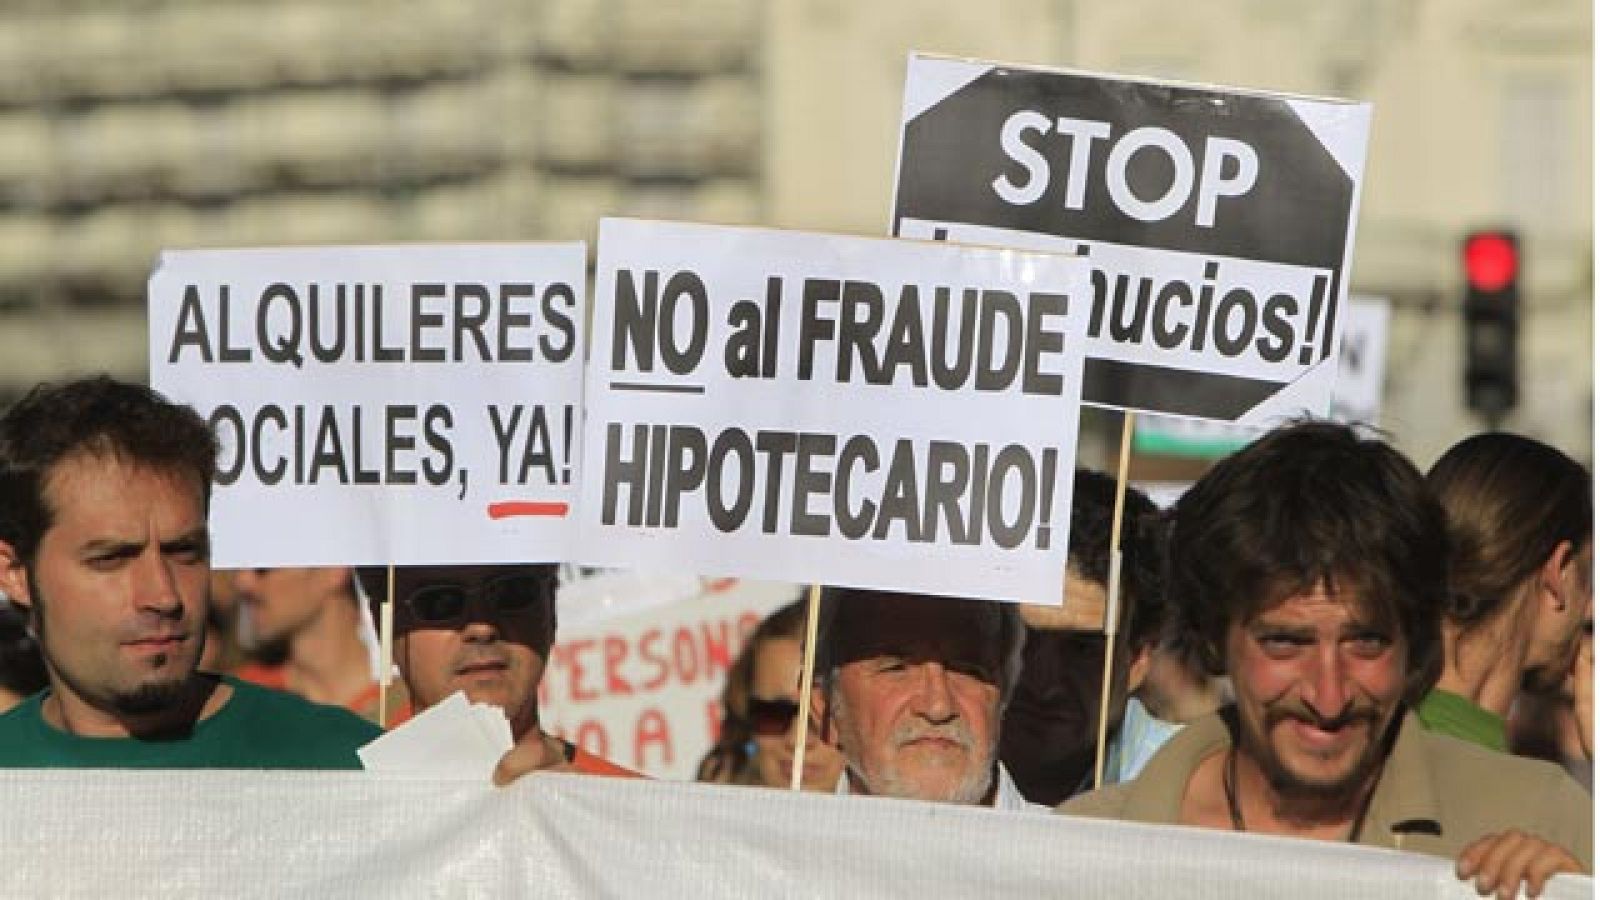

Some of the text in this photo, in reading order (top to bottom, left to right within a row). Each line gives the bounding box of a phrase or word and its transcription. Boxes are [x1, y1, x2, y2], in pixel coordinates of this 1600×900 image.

[992, 110, 1259, 226] STOP
[168, 282, 576, 368] ALQUILERES
[610, 269, 1069, 396] NO al FRAUDE
[208, 404, 573, 500] OCIALES, YA!
[601, 422, 1058, 551] HIPOTECARIO!
